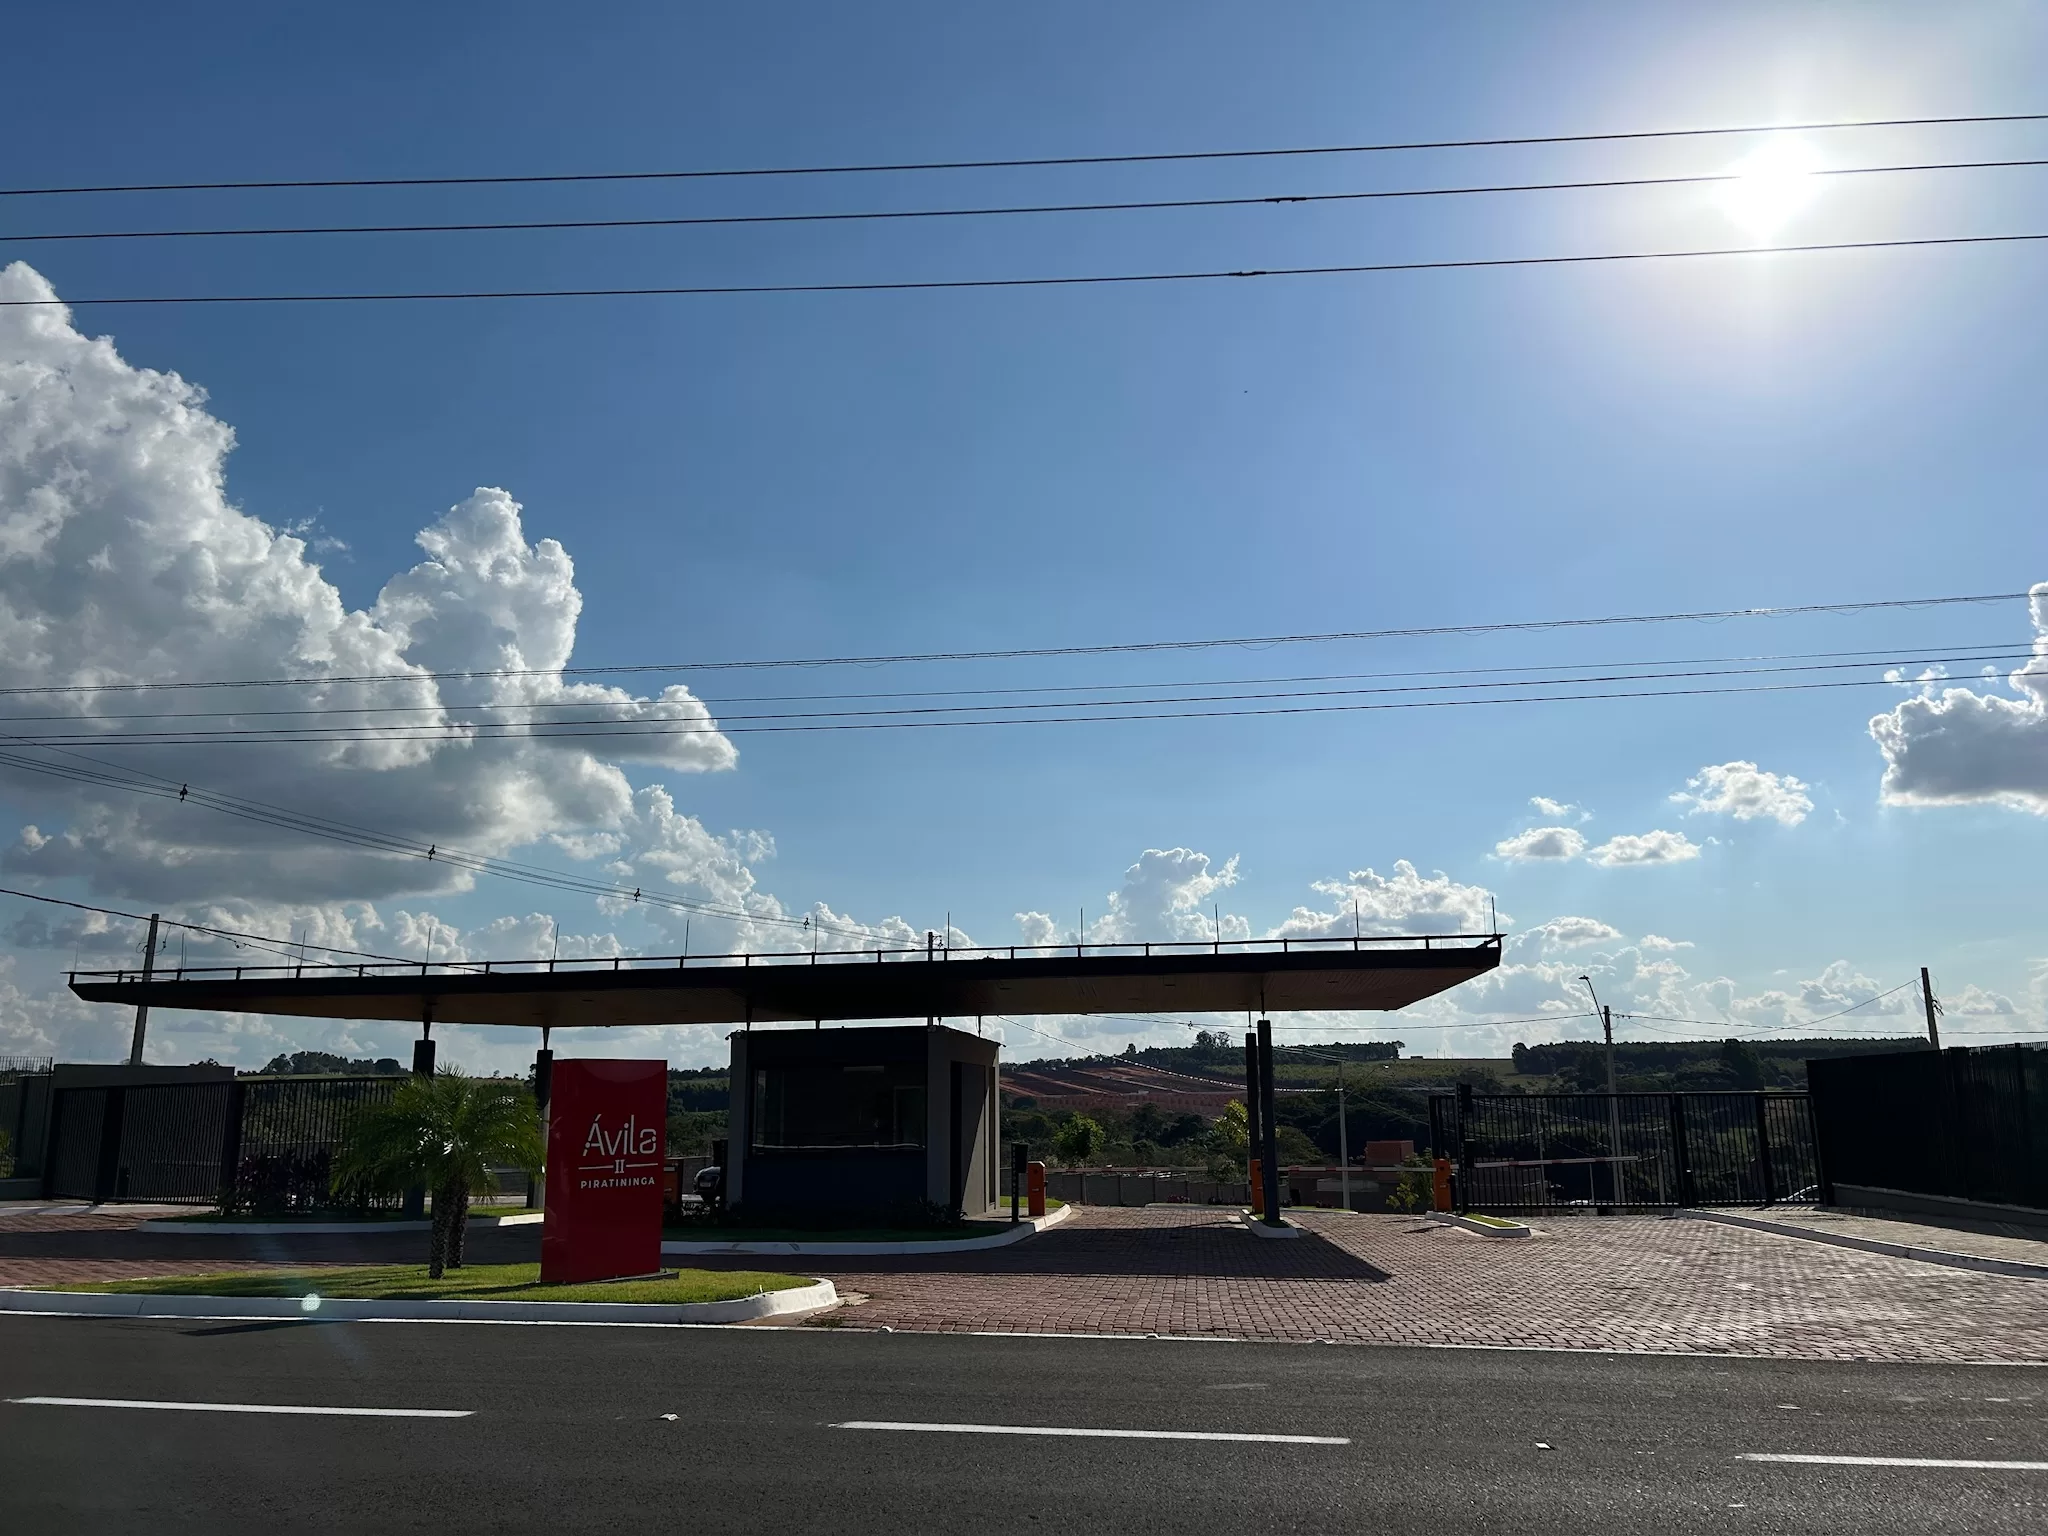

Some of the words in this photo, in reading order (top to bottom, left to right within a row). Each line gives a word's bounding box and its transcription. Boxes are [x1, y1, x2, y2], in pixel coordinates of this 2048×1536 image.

[582, 1114, 657, 1157] Ávila
[614, 1159, 625, 1174] II
[580, 1176, 655, 1189] PIRATININGA
